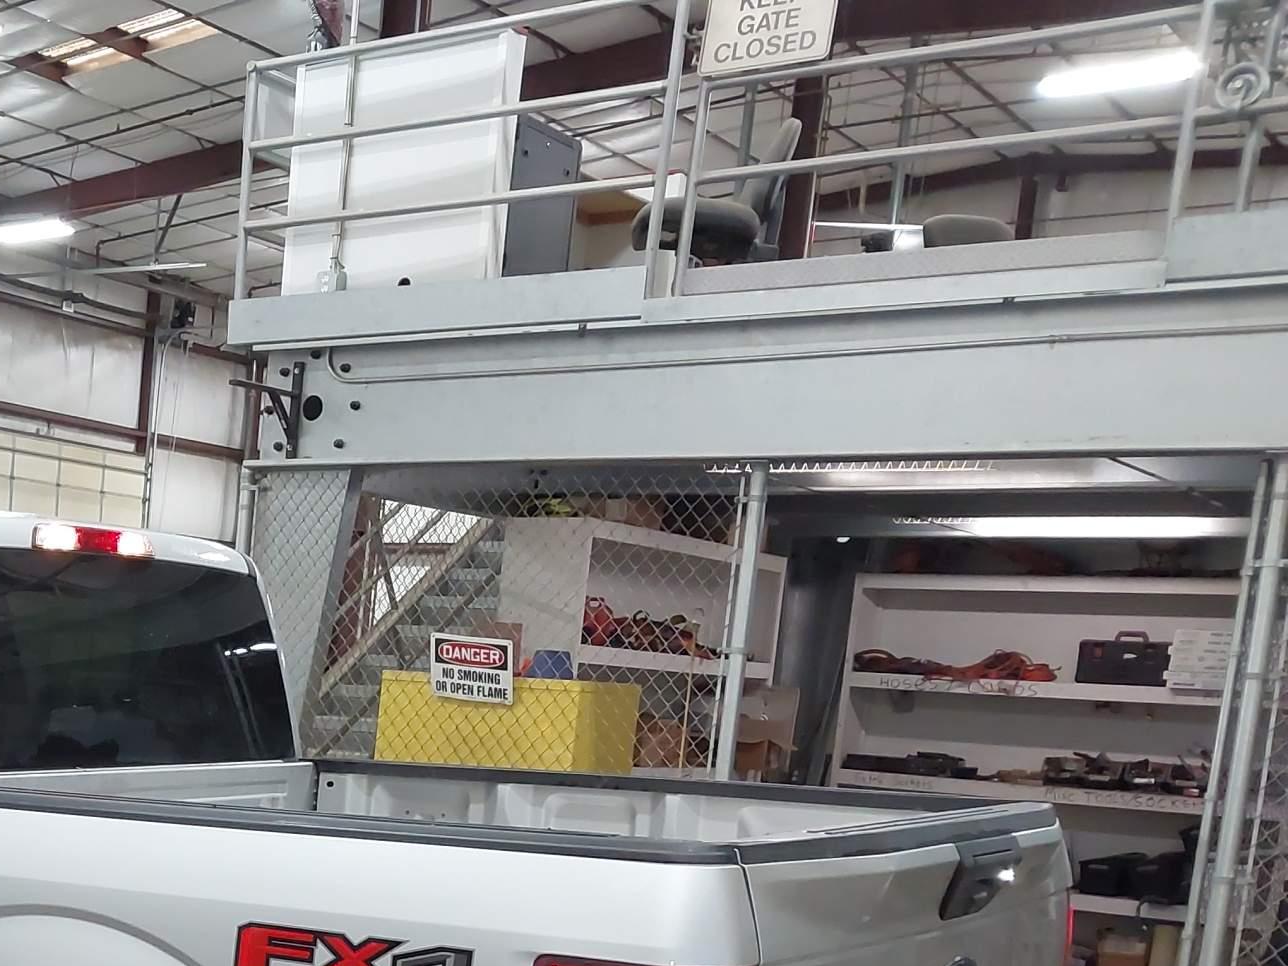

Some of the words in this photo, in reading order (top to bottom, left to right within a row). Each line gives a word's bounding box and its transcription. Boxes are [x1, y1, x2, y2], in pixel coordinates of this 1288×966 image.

[737, 7, 802, 36] GATE
[713, 30, 817, 64] CLOSED
[442, 645, 500, 664] DANGER
[442, 667, 455, 680] NO
[457, 669, 501, 685] SMOKING
[435, 680, 448, 692] OR
[450, 682, 474, 696] OPEN
[476, 685, 509, 700] FLAME
